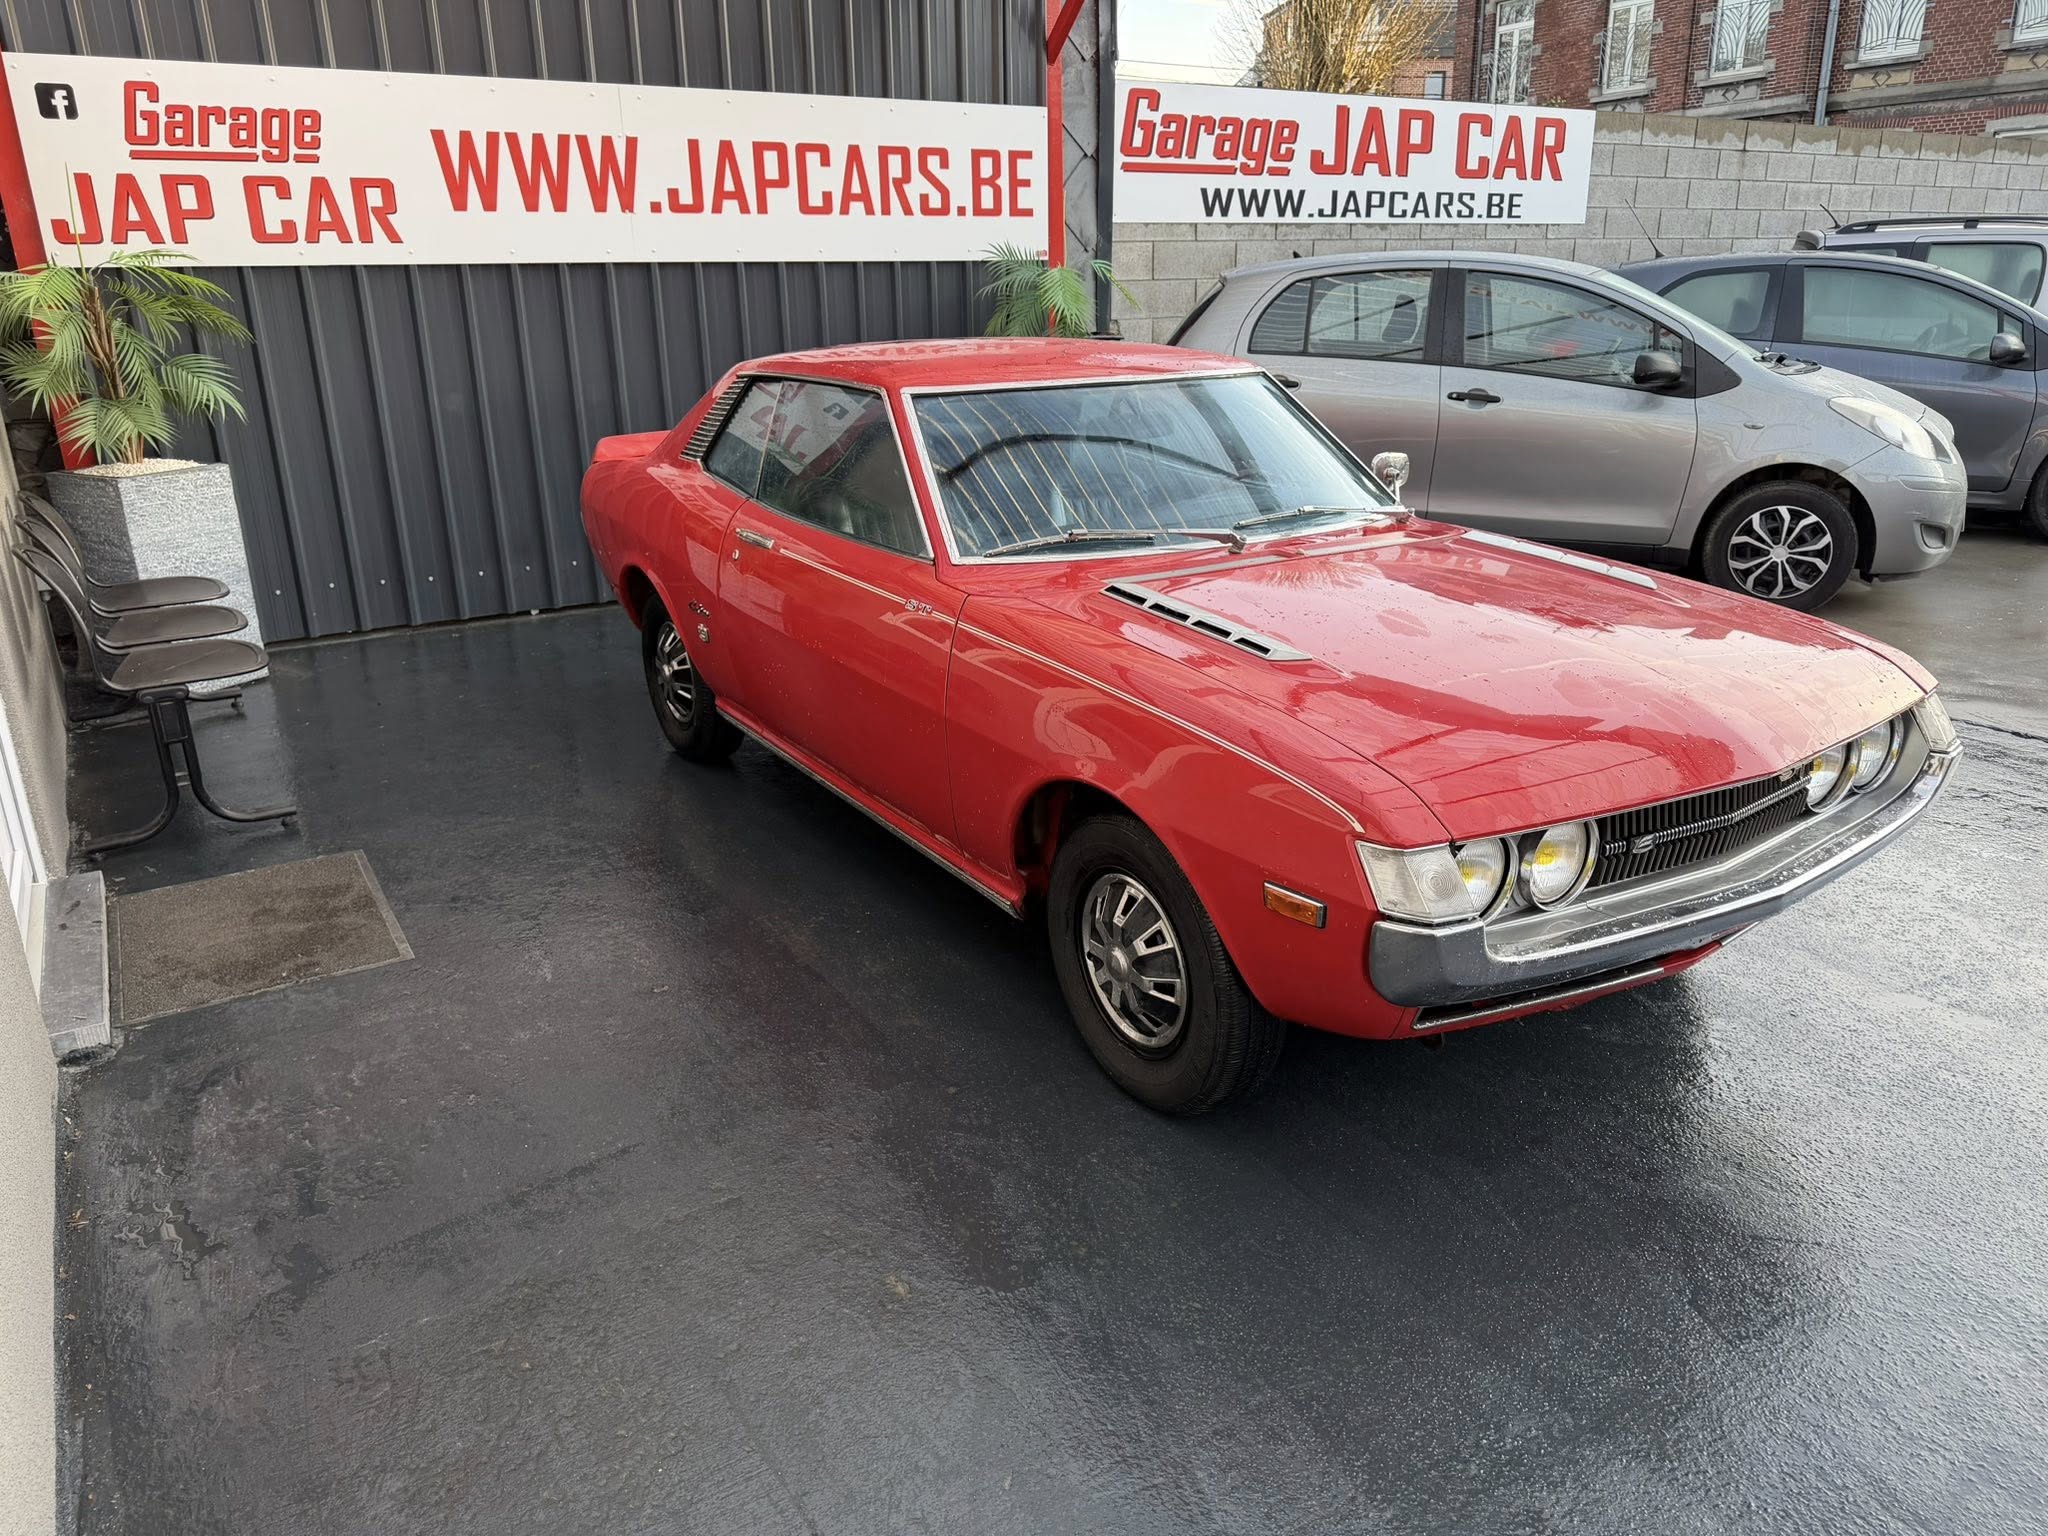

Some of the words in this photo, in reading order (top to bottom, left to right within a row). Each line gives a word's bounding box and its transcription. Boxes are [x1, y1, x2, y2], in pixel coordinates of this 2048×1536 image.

[123, 80, 322, 164] Garage
[1119, 87, 1300, 177] Garage
[1309, 105, 1436, 178] JAP
[1455, 112, 1568, 182] CAR
[50, 171, 216, 246] JAP
[242, 175, 405, 245] CAR
[430, 129, 1035, 219] WWW.JAPCARS.BE
[1200, 187, 1523, 219] WWW.JAPCARS.BE
